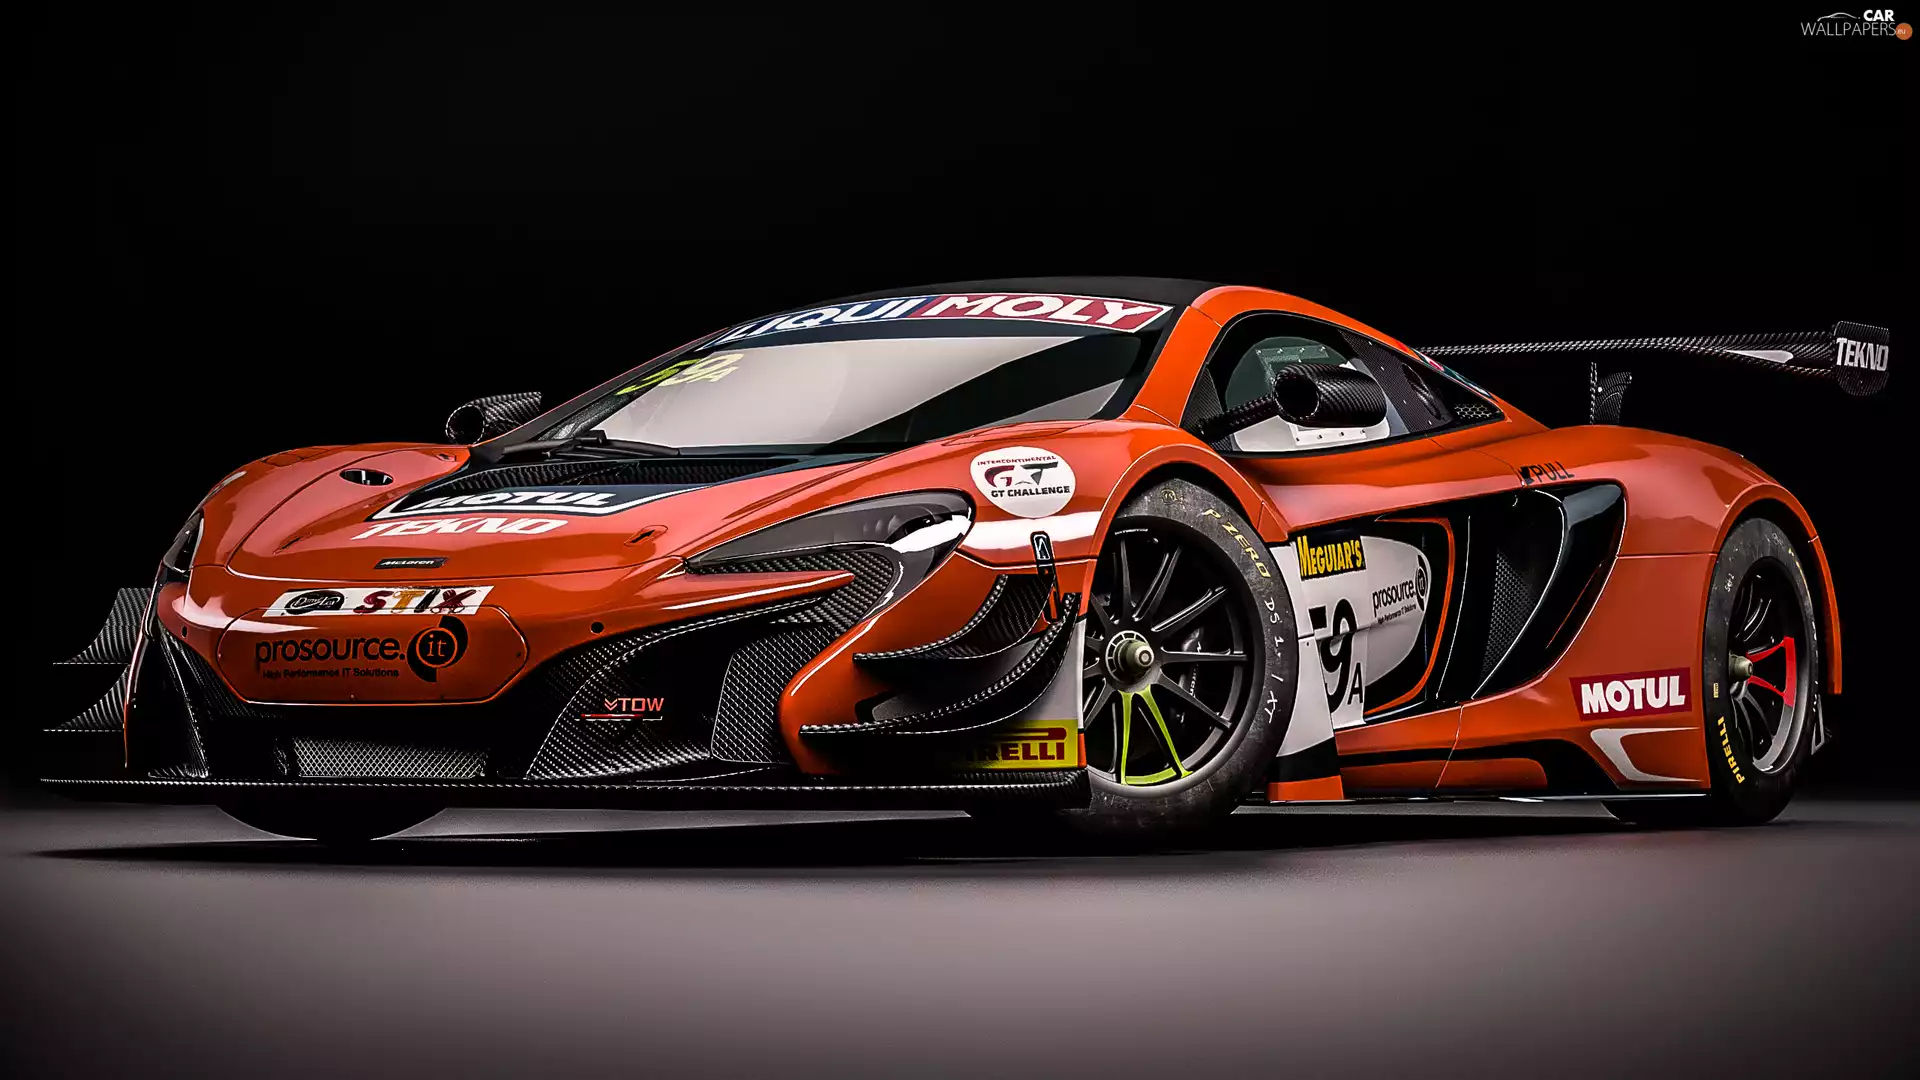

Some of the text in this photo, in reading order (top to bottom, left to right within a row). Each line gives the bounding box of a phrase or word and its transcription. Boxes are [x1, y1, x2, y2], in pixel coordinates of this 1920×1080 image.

[713, 295, 1160, 346] LIQUI MOLY
[1836, 337, 1889, 371] TEKNO
[1528, 461, 1576, 483] PULL
[402, 491, 617, 511] MOTUL
[991, 485, 1071, 498] GT CHALLENGE
[351, 517, 569, 541] TEKNO
[1222, 521, 1271, 578] ZERO
[353, 588, 477, 615] STIX
[254, 636, 406, 674] prosource.
[353, 667, 400, 678] Solutions
[617, 698, 665, 712] TOW
[1580, 675, 1686, 715] MOTUL
[1717, 716, 1746, 784] PIRELLI
